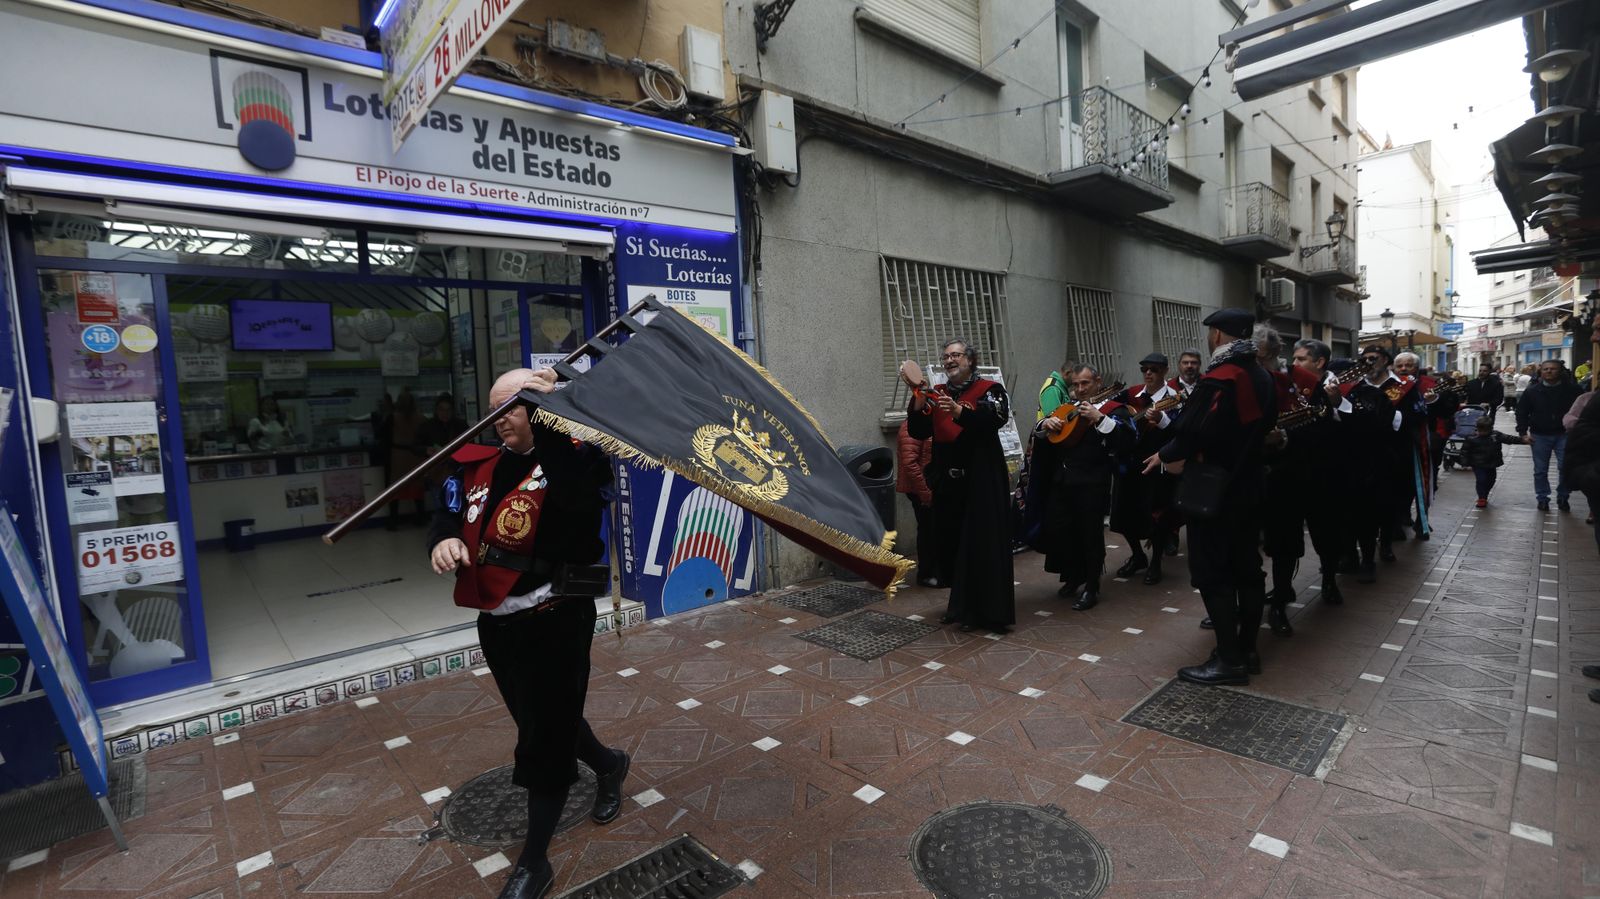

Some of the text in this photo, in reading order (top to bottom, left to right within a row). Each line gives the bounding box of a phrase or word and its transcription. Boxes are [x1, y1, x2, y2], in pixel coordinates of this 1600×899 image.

[434, 34, 450, 88] 26
[472, 117, 489, 144] y
[499, 117, 621, 161] Apuestas
[472, 144, 612, 188] del Estado
[356, 167, 371, 182] El
[377, 169, 422, 191] Piojo
[427, 176, 447, 192] de
[451, 179, 465, 194] la
[469, 182, 519, 201] Suerte
[626, 236, 644, 256] Si
[666, 262, 732, 285] Loterías
[667, 289, 696, 301] BOTES
[722, 394, 811, 476] TUNA VETERANOS
[619, 464, 634, 574] del Estado
[81, 541, 176, 568] 01568
[103, 530, 168, 547] PREMIO
